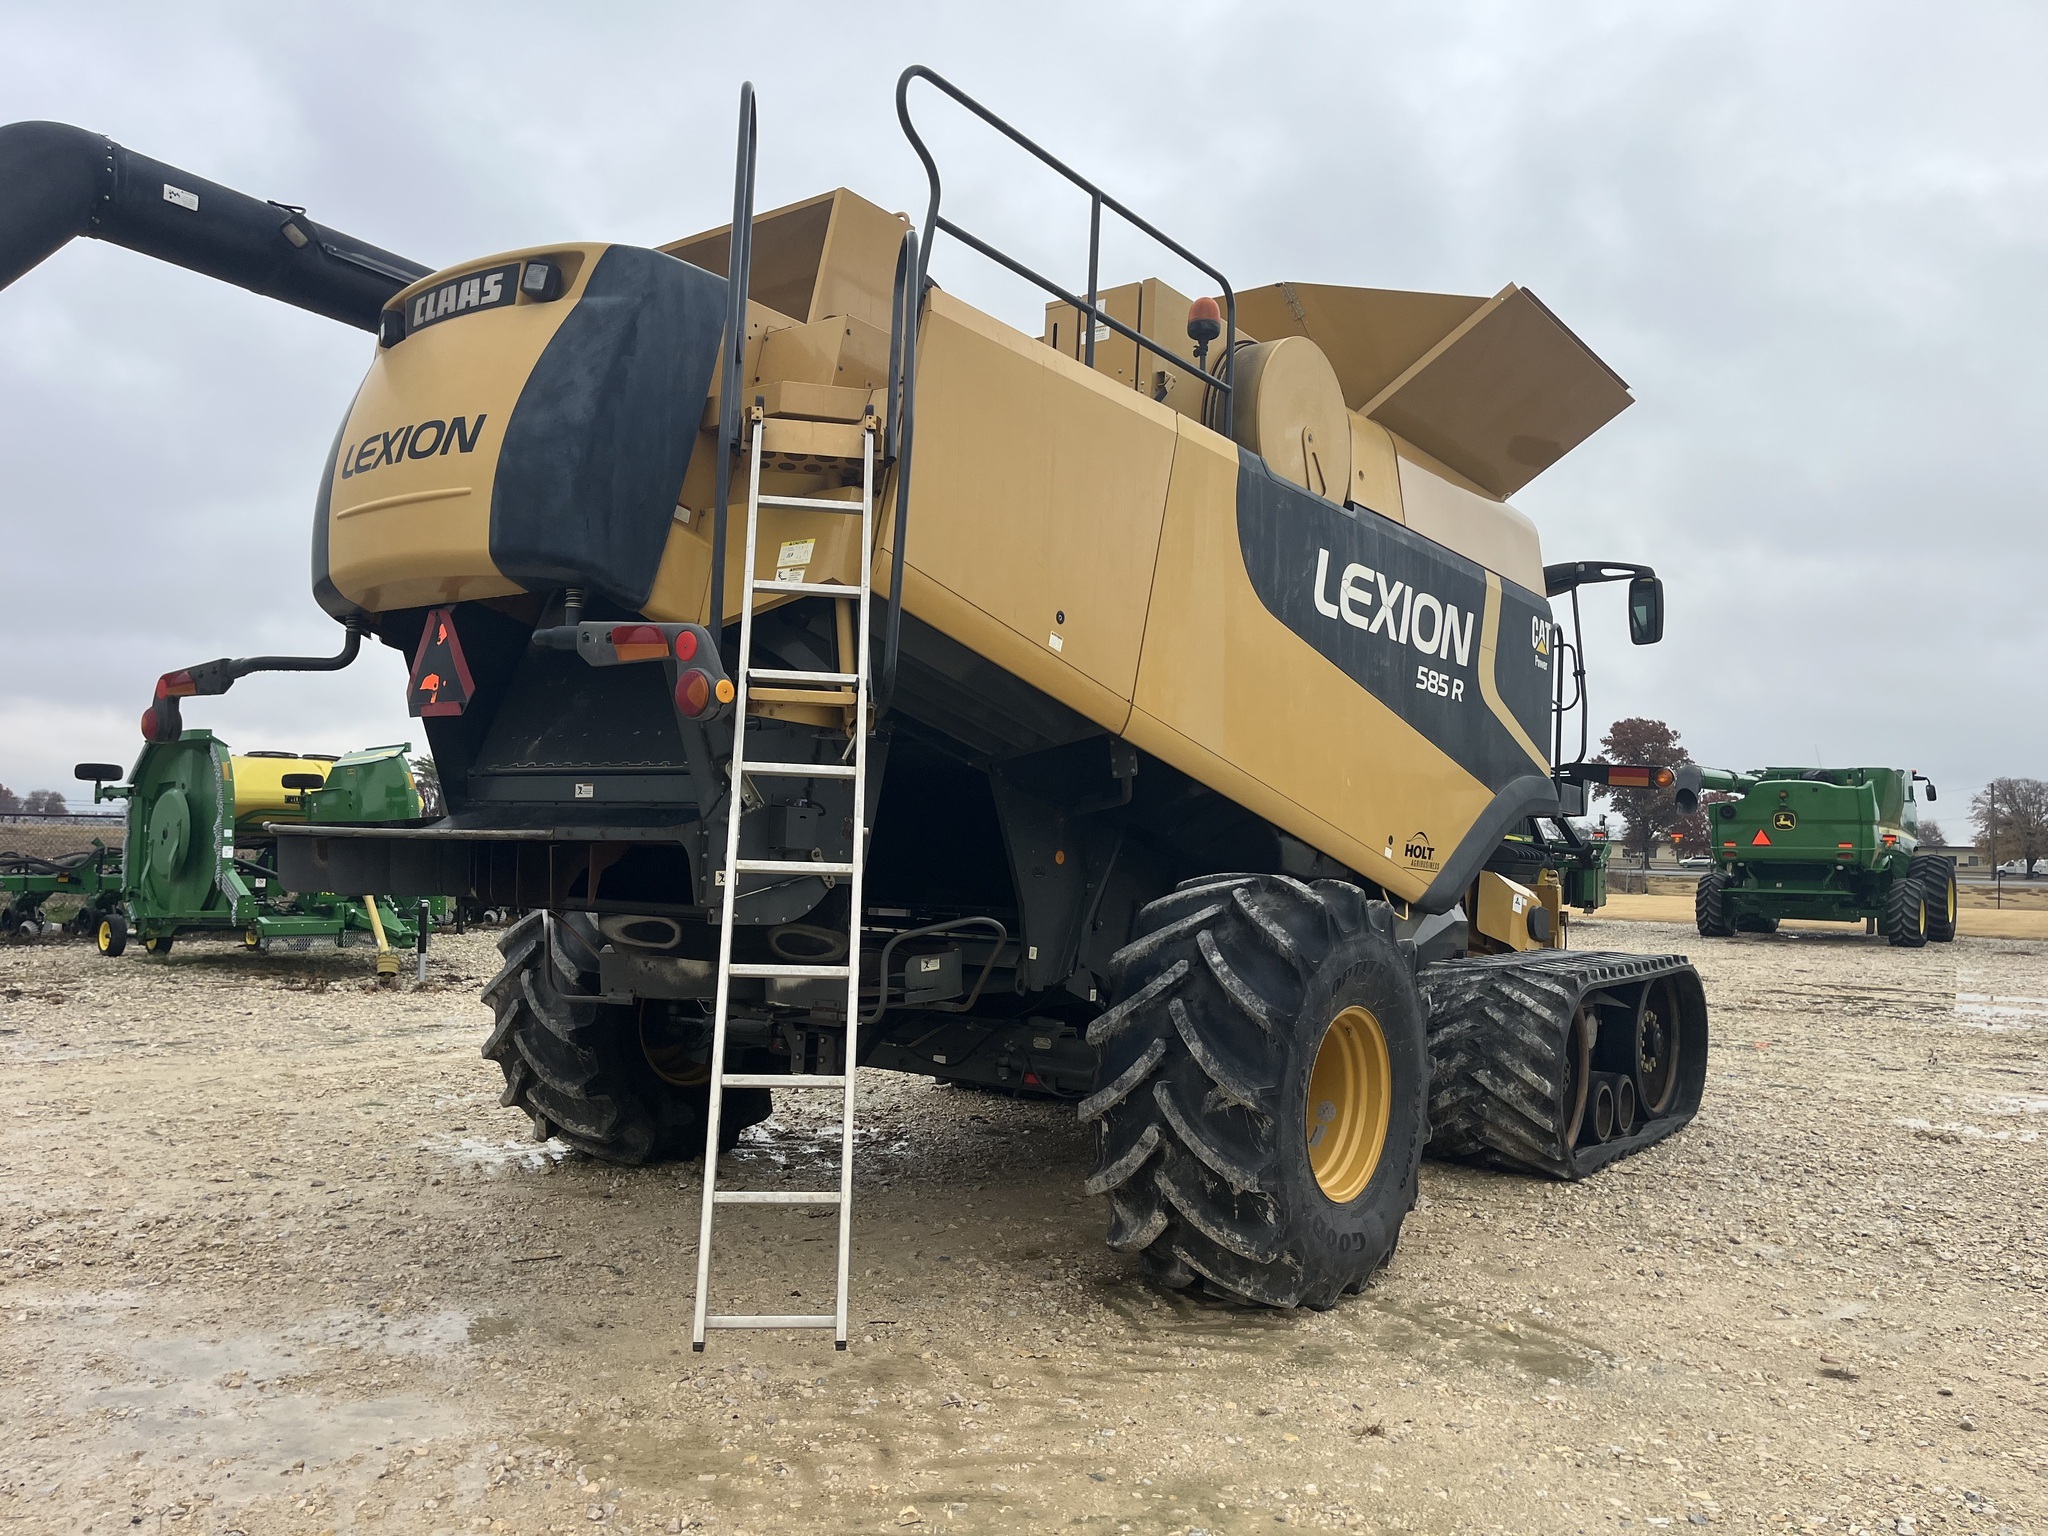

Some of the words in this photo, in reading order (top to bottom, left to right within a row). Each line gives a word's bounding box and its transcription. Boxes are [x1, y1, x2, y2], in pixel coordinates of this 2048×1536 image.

[411, 271, 505, 327] CLAAS
[341, 413, 487, 480] LEXION
[1314, 548, 1475, 667] LEXION
[1532, 615, 1552, 656] CAT
[1534, 654, 1548, 671] Power
[1415, 665, 1450, 698] 585
[1451, 678, 1465, 703] R
[1404, 843, 1435, 860] HOLT
